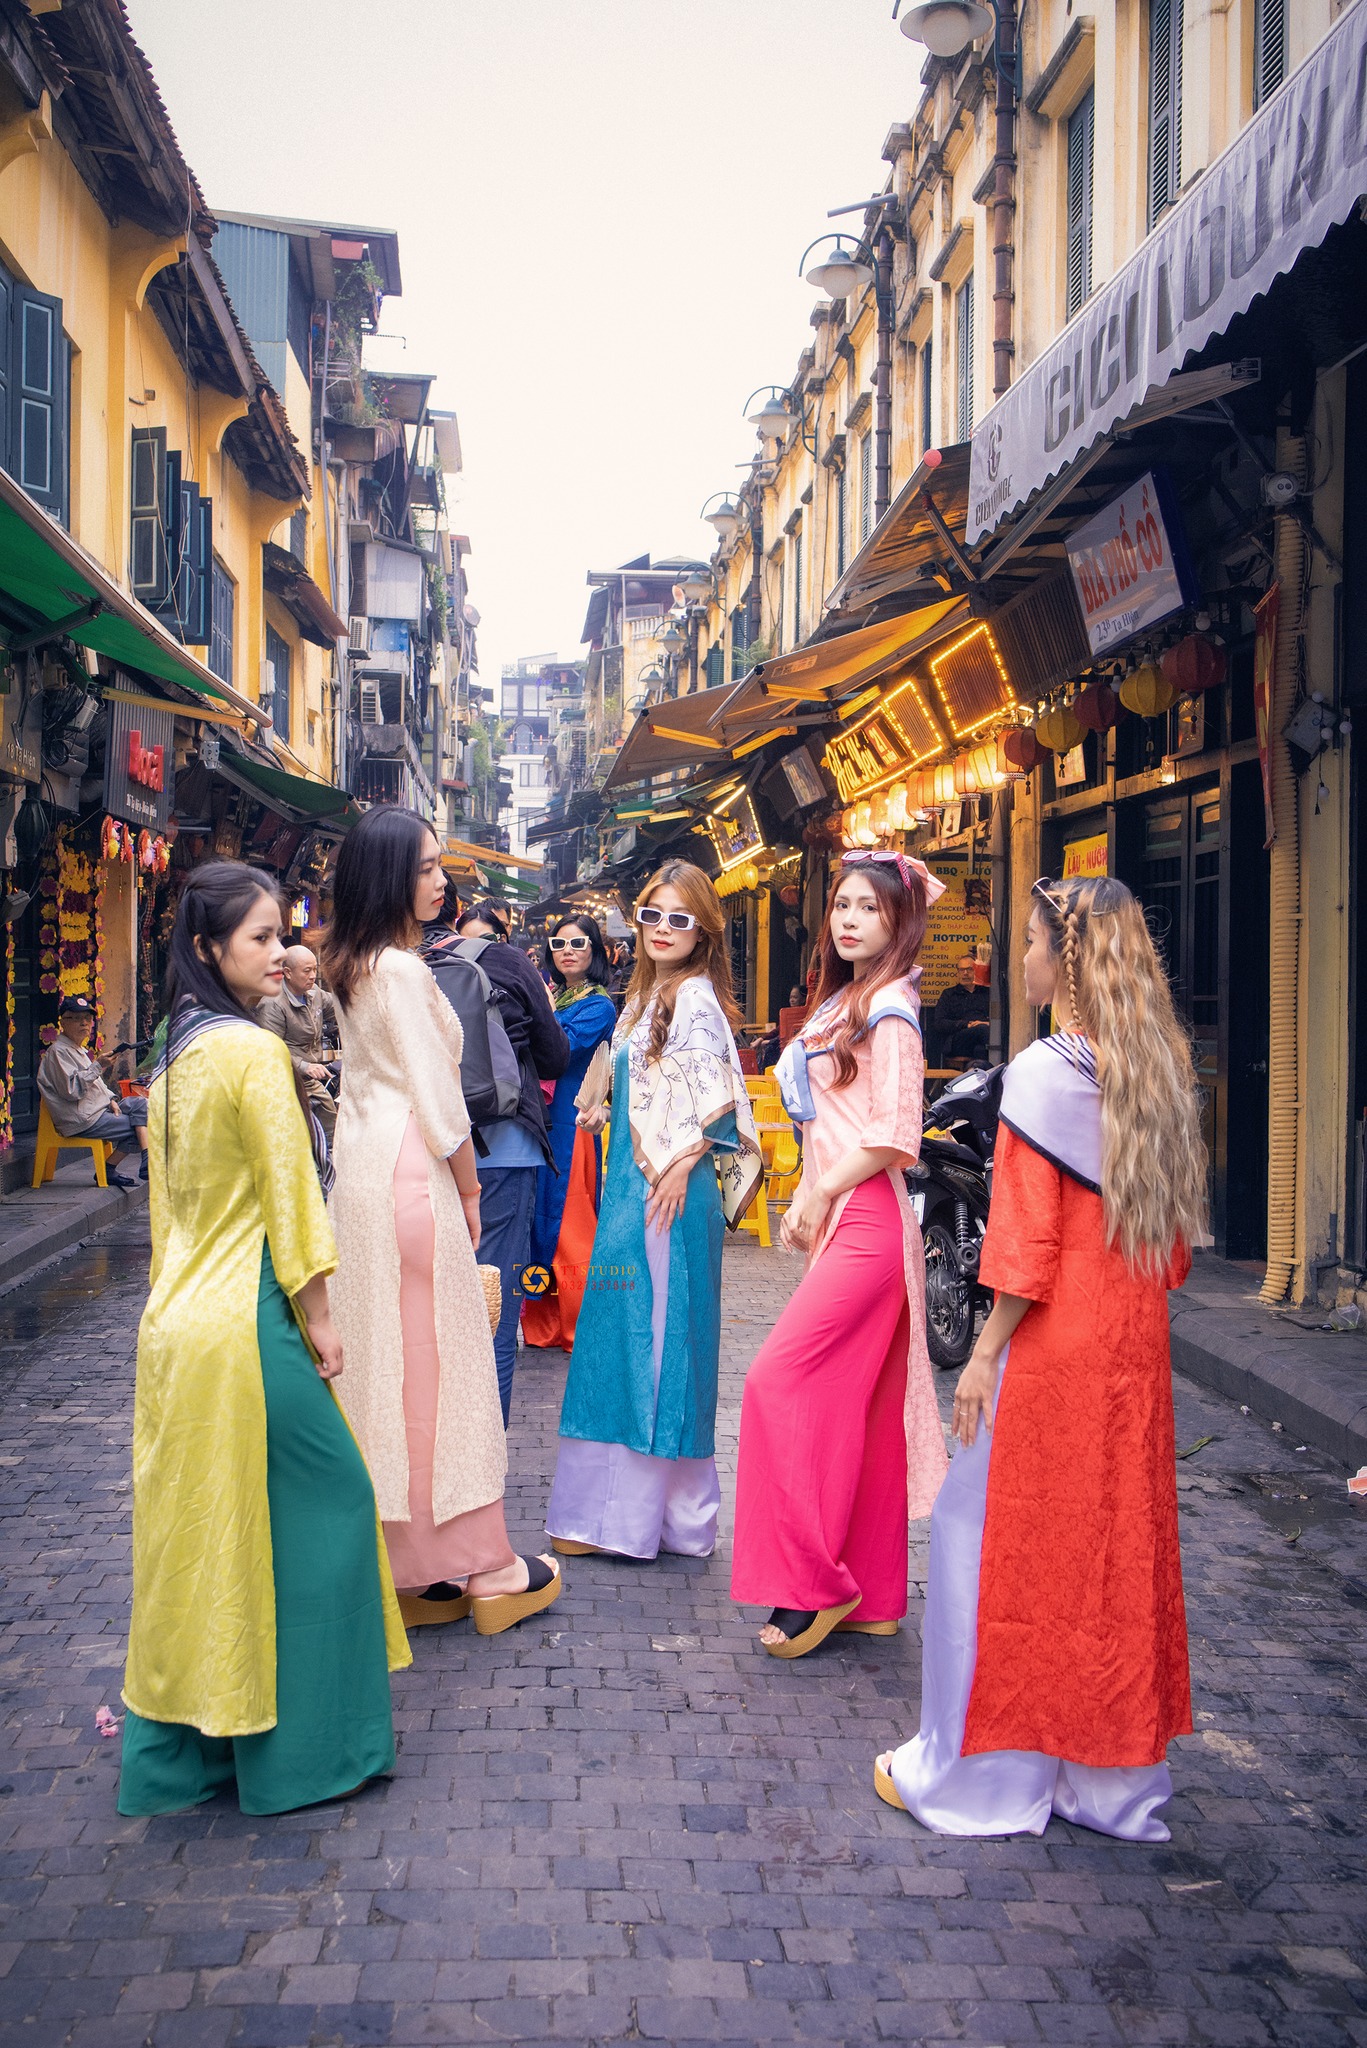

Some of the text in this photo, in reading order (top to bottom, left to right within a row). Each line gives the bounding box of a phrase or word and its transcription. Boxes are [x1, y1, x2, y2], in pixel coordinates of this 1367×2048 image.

[1044, 291, 1140, 454] CICI
[1076, 556, 1110, 614] BIA
[868, 726, 888, 753] 21
[935, 867, 958, 876] BBQ
[933, 934, 977, 942] HOTPOT
